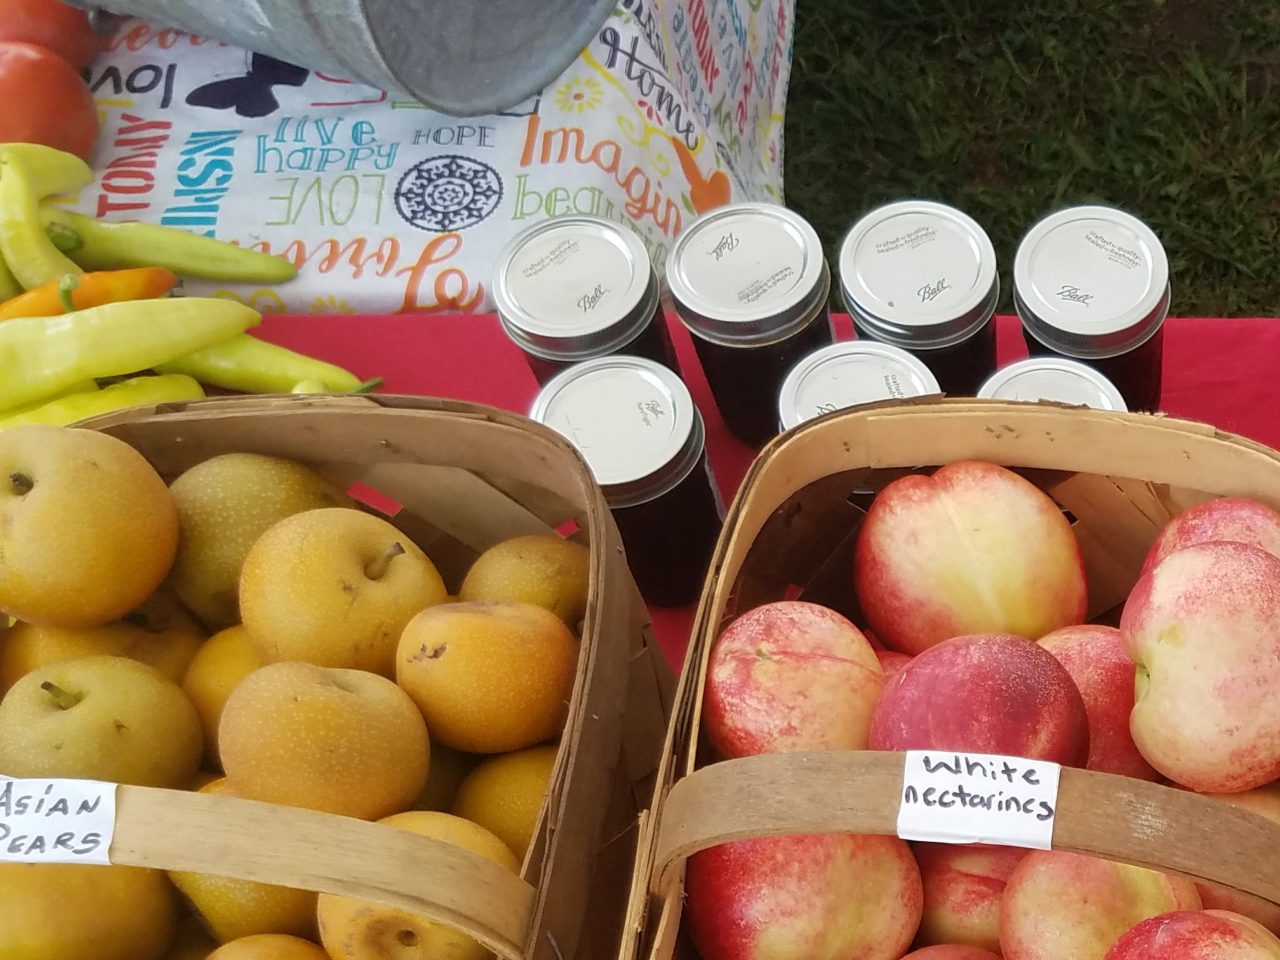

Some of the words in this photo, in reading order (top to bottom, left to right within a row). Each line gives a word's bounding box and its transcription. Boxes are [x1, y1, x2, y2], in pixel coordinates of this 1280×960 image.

[84, 63, 178, 109] lov
[274, 115, 377, 146] live
[412, 125, 497, 148] HOPE
[254, 134, 400, 175] happy
[520, 113, 682, 239] Imagin
[265, 173, 386, 226] LOVE
[708, 232, 740, 261] Ball
[577, 284, 610, 313] Ball
[917, 278, 952, 303] Ball
[1055, 285, 1093, 305] Ball
